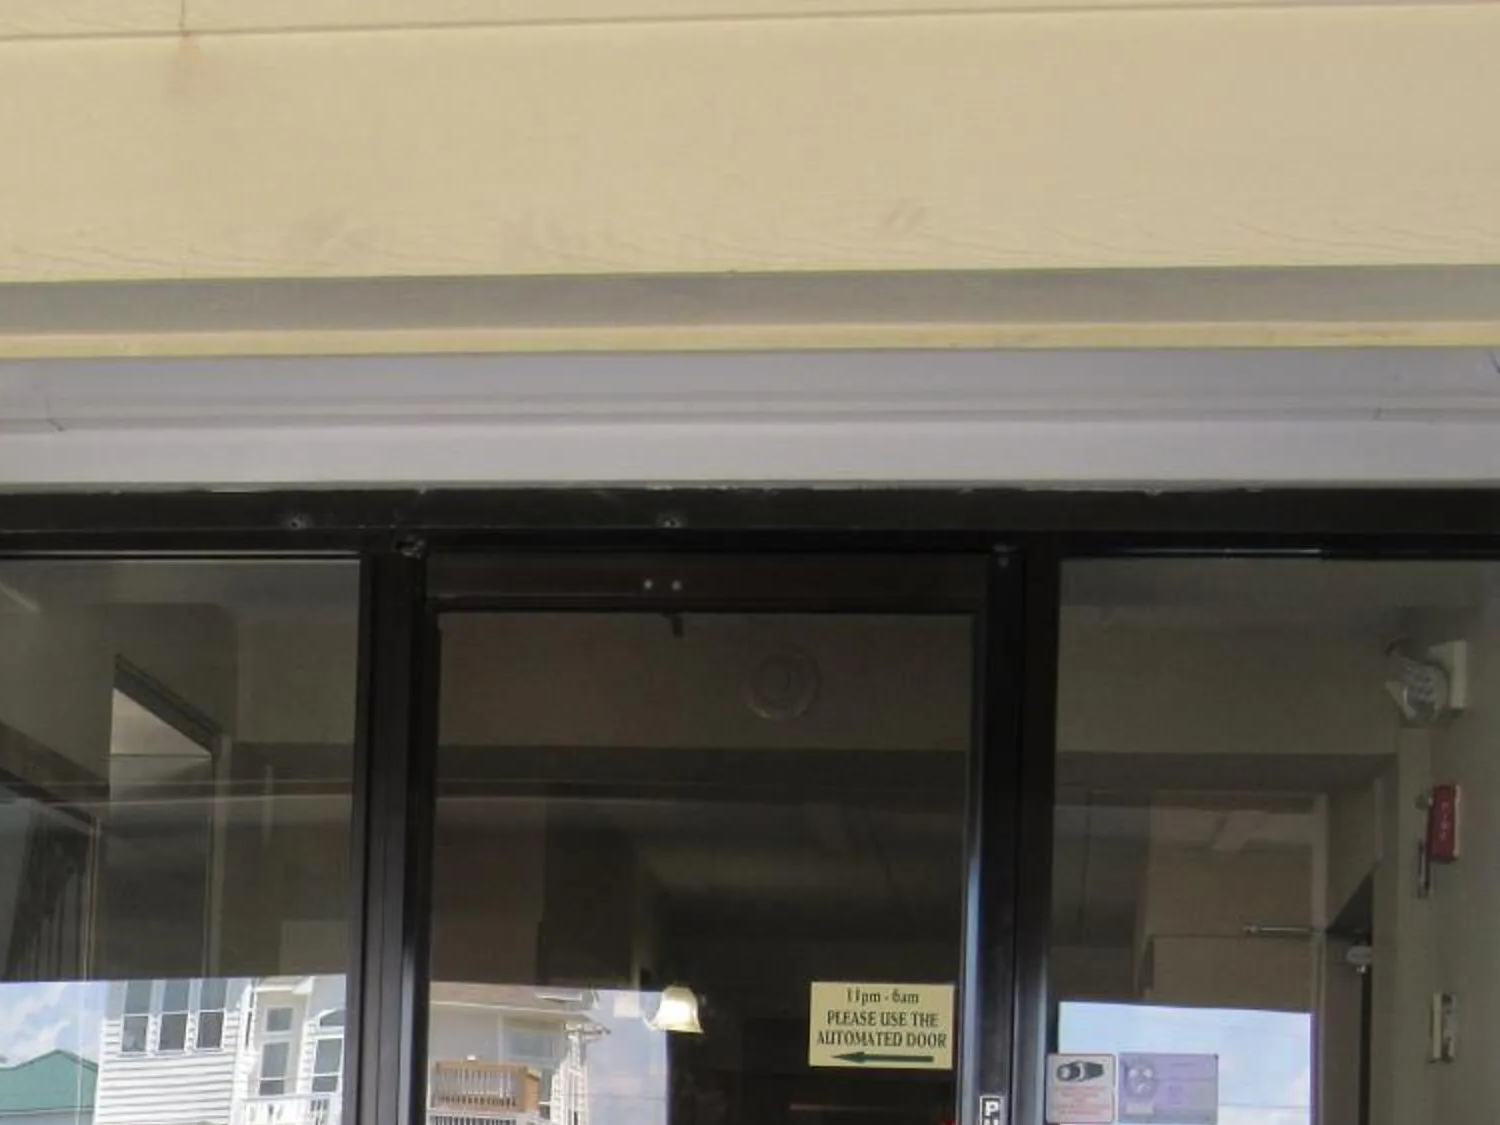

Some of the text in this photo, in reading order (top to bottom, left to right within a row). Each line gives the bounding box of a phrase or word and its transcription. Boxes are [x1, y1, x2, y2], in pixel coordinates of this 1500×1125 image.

[847, 987, 881, 1006] 11pm
[891, 988, 920, 1004] 6am
[827, 1009, 940, 1028] PLEASE USE THE
[817, 1029, 948, 1049] AUTOMATED DOOR
